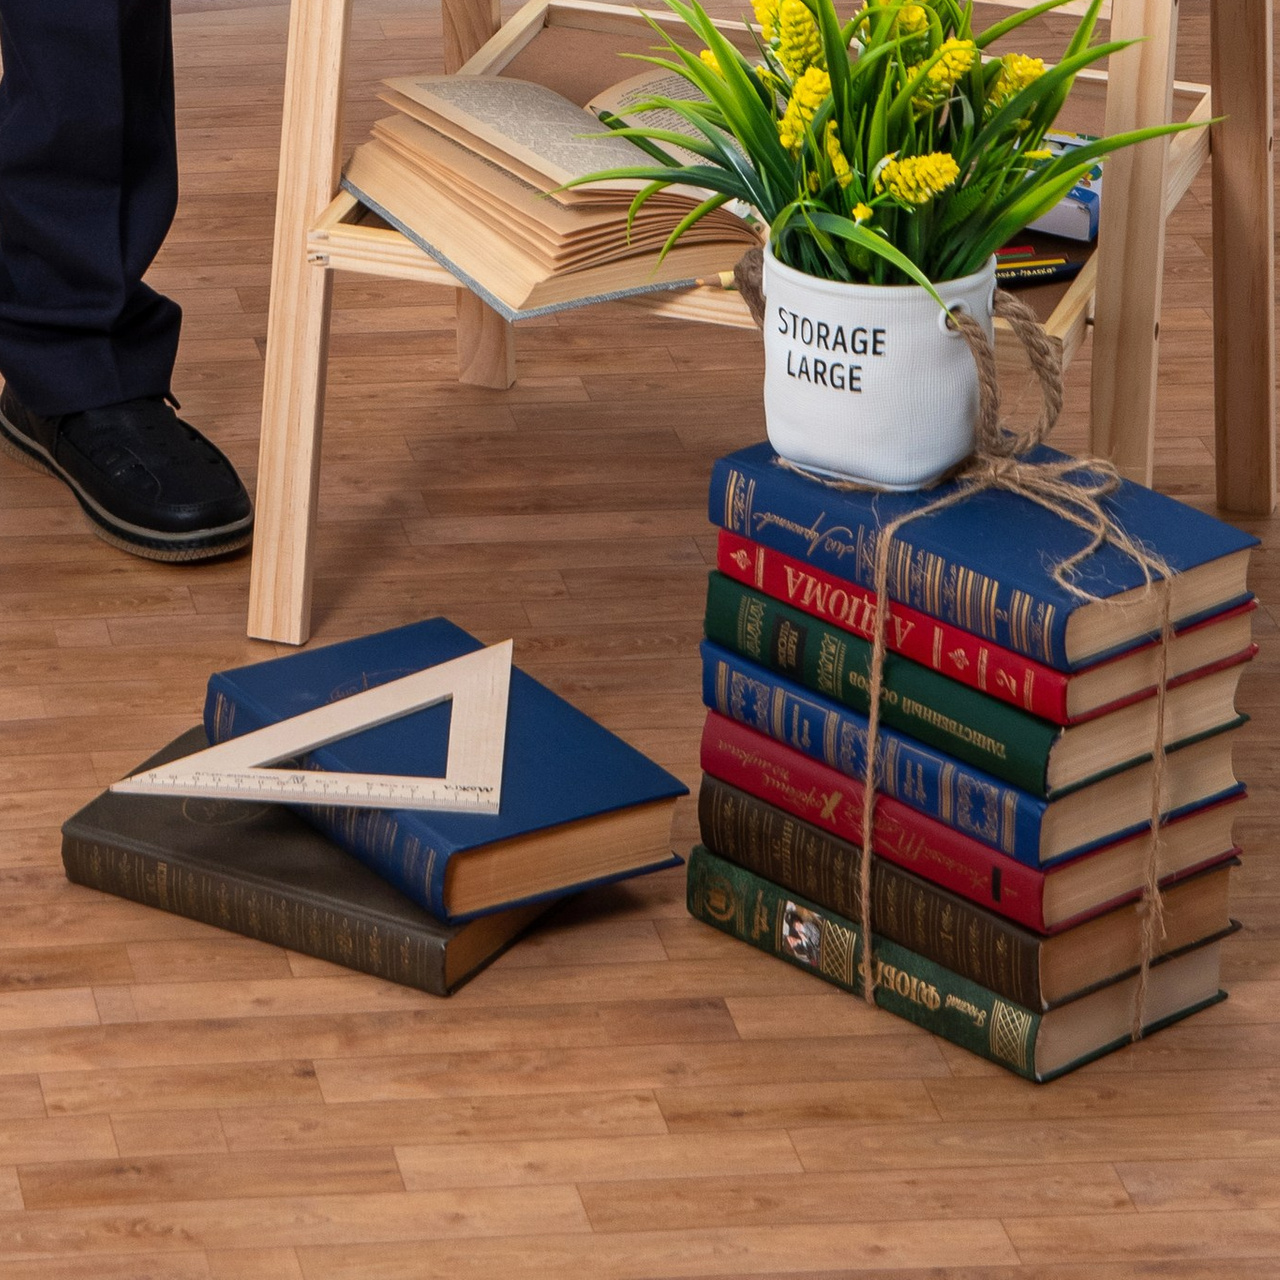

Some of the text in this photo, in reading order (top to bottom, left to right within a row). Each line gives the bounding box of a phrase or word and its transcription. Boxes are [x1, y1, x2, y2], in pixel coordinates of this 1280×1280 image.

[777, 306, 887, 356] STORAGE
[786, 350, 863, 394] LARGE
[994, 669, 1018, 698] 2
